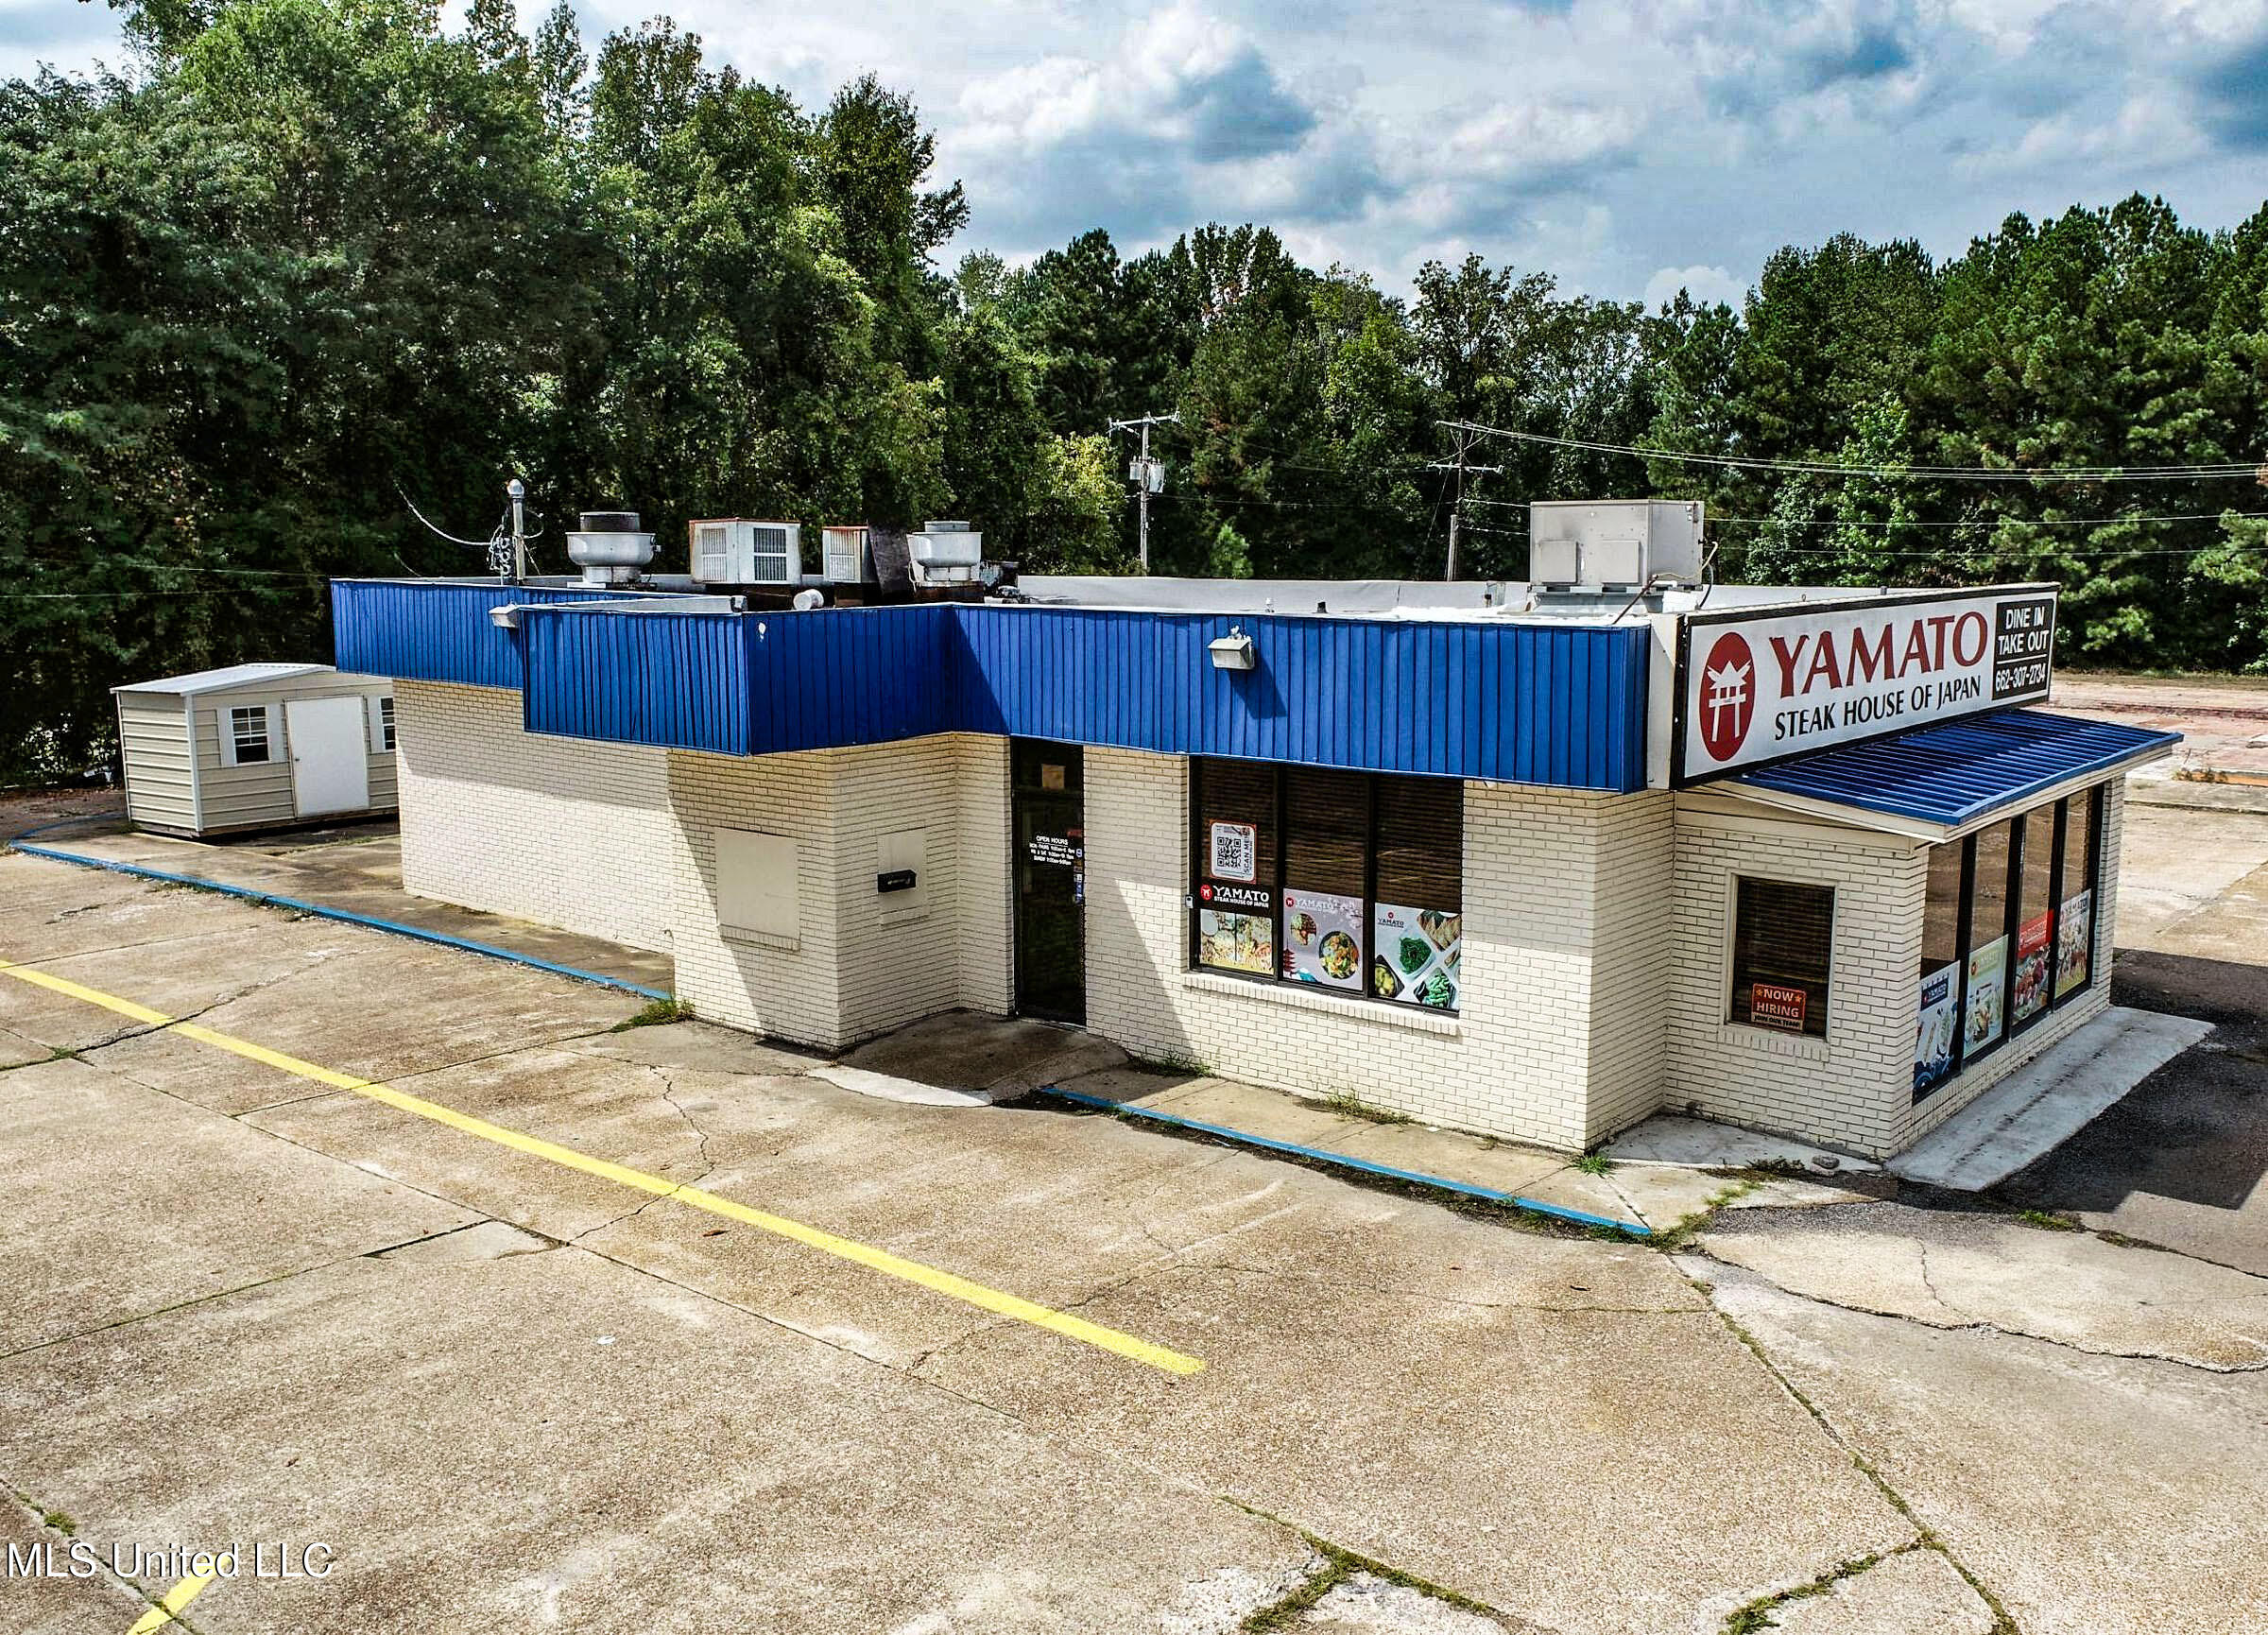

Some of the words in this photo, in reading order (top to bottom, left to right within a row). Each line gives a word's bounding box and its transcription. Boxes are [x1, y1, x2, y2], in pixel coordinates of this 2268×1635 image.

[2005, 608, 2031, 629] DINE
[2034, 606, 2045, 627] IN
[1998, 632, 2024, 655] TAKE
[2027, 629, 2049, 652] OUT
[1769, 611, 1988, 698] YAMATO
[1995, 663, 2046, 692] 662-307-2734
[1775, 703, 1835, 741] STEAK
[1844, 690, 1905, 727] HOUSE
[1911, 684, 1933, 711] OF
[1937, 675, 1982, 711] JAPAN
[1212, 885, 1270, 903] YAMATO
[1763, 989, 1794, 1002] NOW
[1756, 1002, 1799, 1018] HIRING
